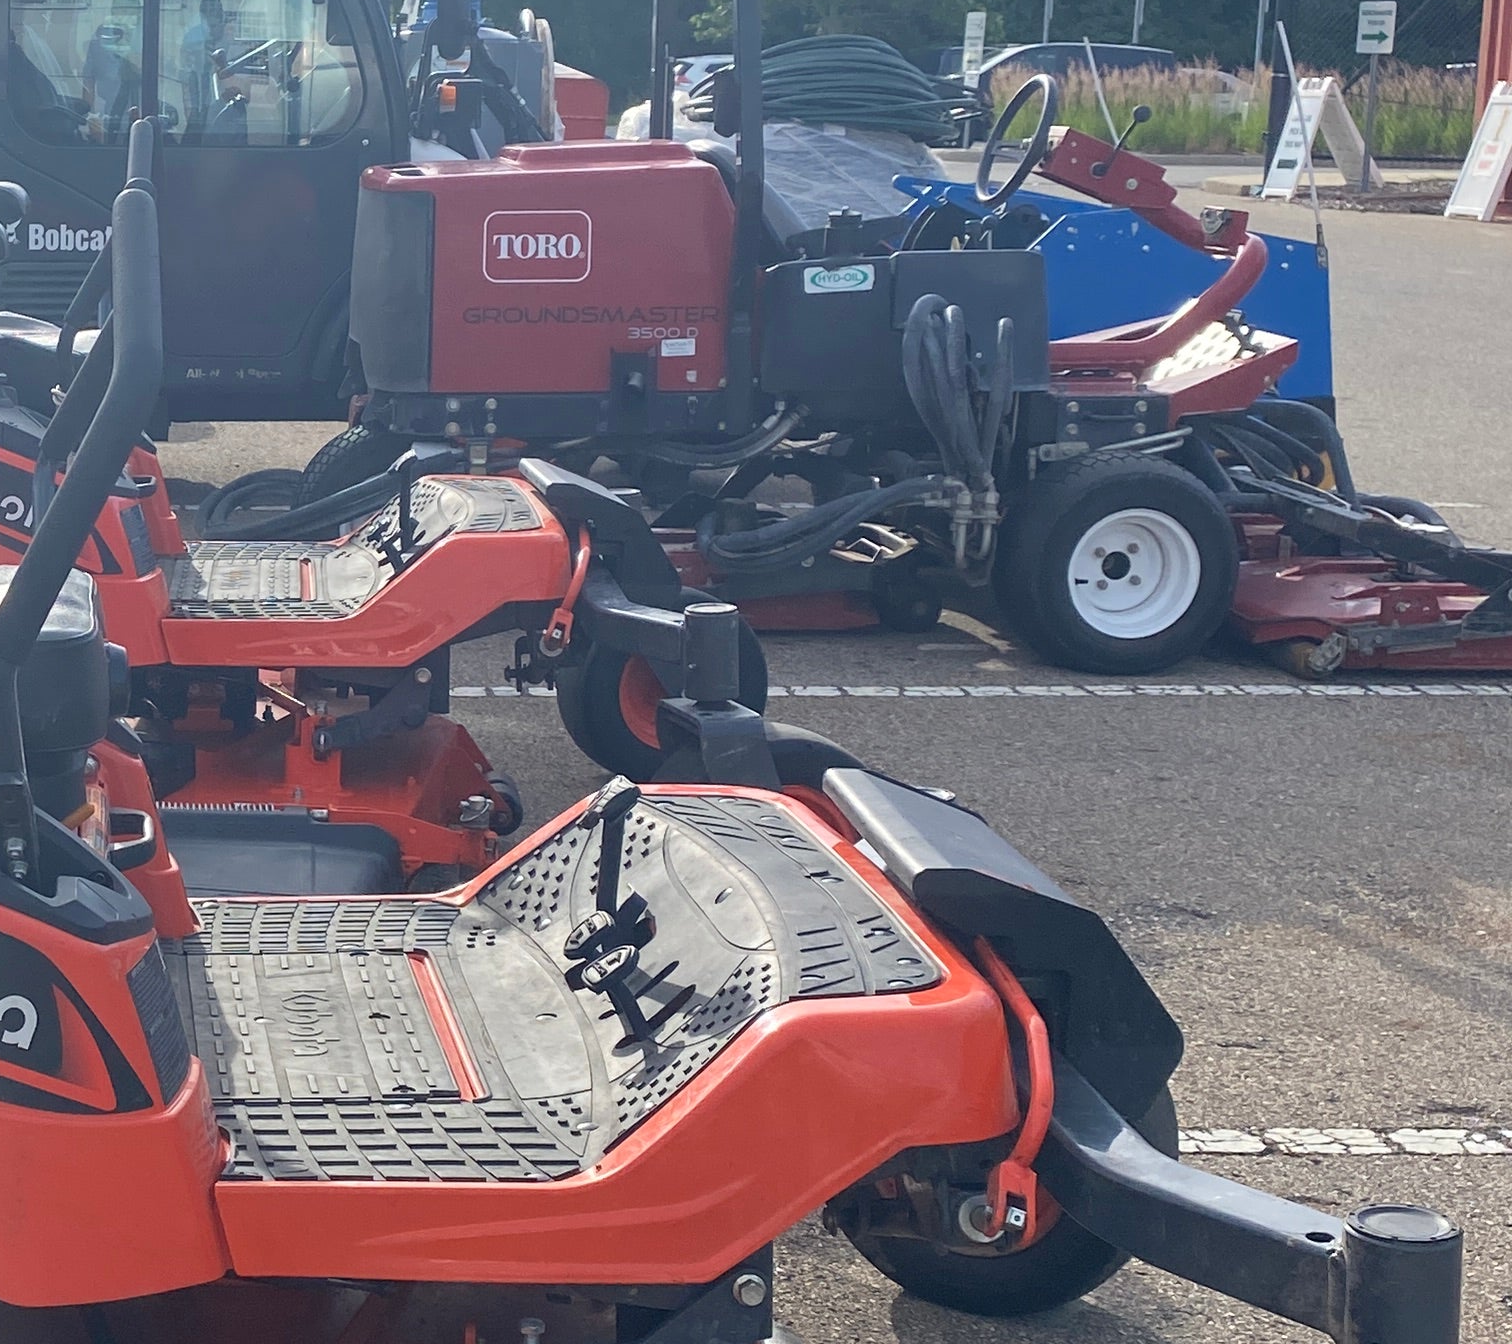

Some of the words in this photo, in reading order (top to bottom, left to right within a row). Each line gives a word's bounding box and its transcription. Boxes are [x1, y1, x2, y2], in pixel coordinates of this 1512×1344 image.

[492, 233, 582, 260] TORO
[817, 272, 862, 283] HYD-OIL
[462, 306, 719, 324] GROUNDSMASTER
[627, 327, 681, 339] 3500
[687, 327, 699, 338] D
[281, 988, 341, 1057] Kubota
